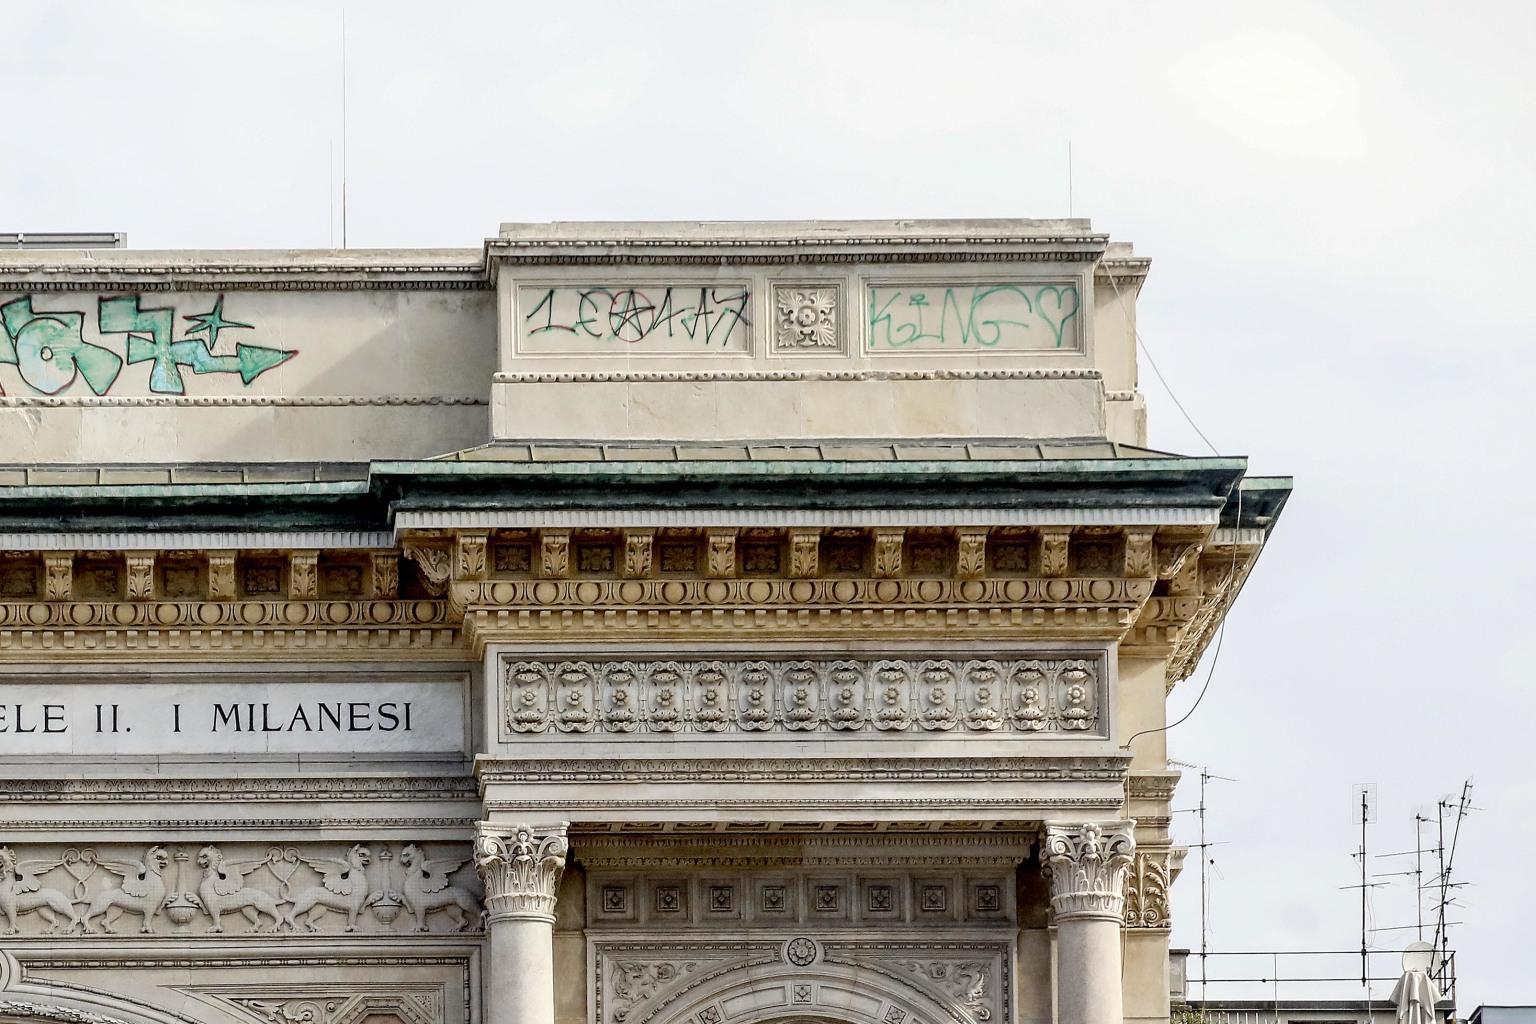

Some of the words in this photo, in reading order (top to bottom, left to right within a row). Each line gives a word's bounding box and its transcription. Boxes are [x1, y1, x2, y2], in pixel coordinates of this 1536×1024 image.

[94, 703, 131, 733] II.
[172, 703, 181, 733] I
[211, 702, 413, 732] MILANESI
